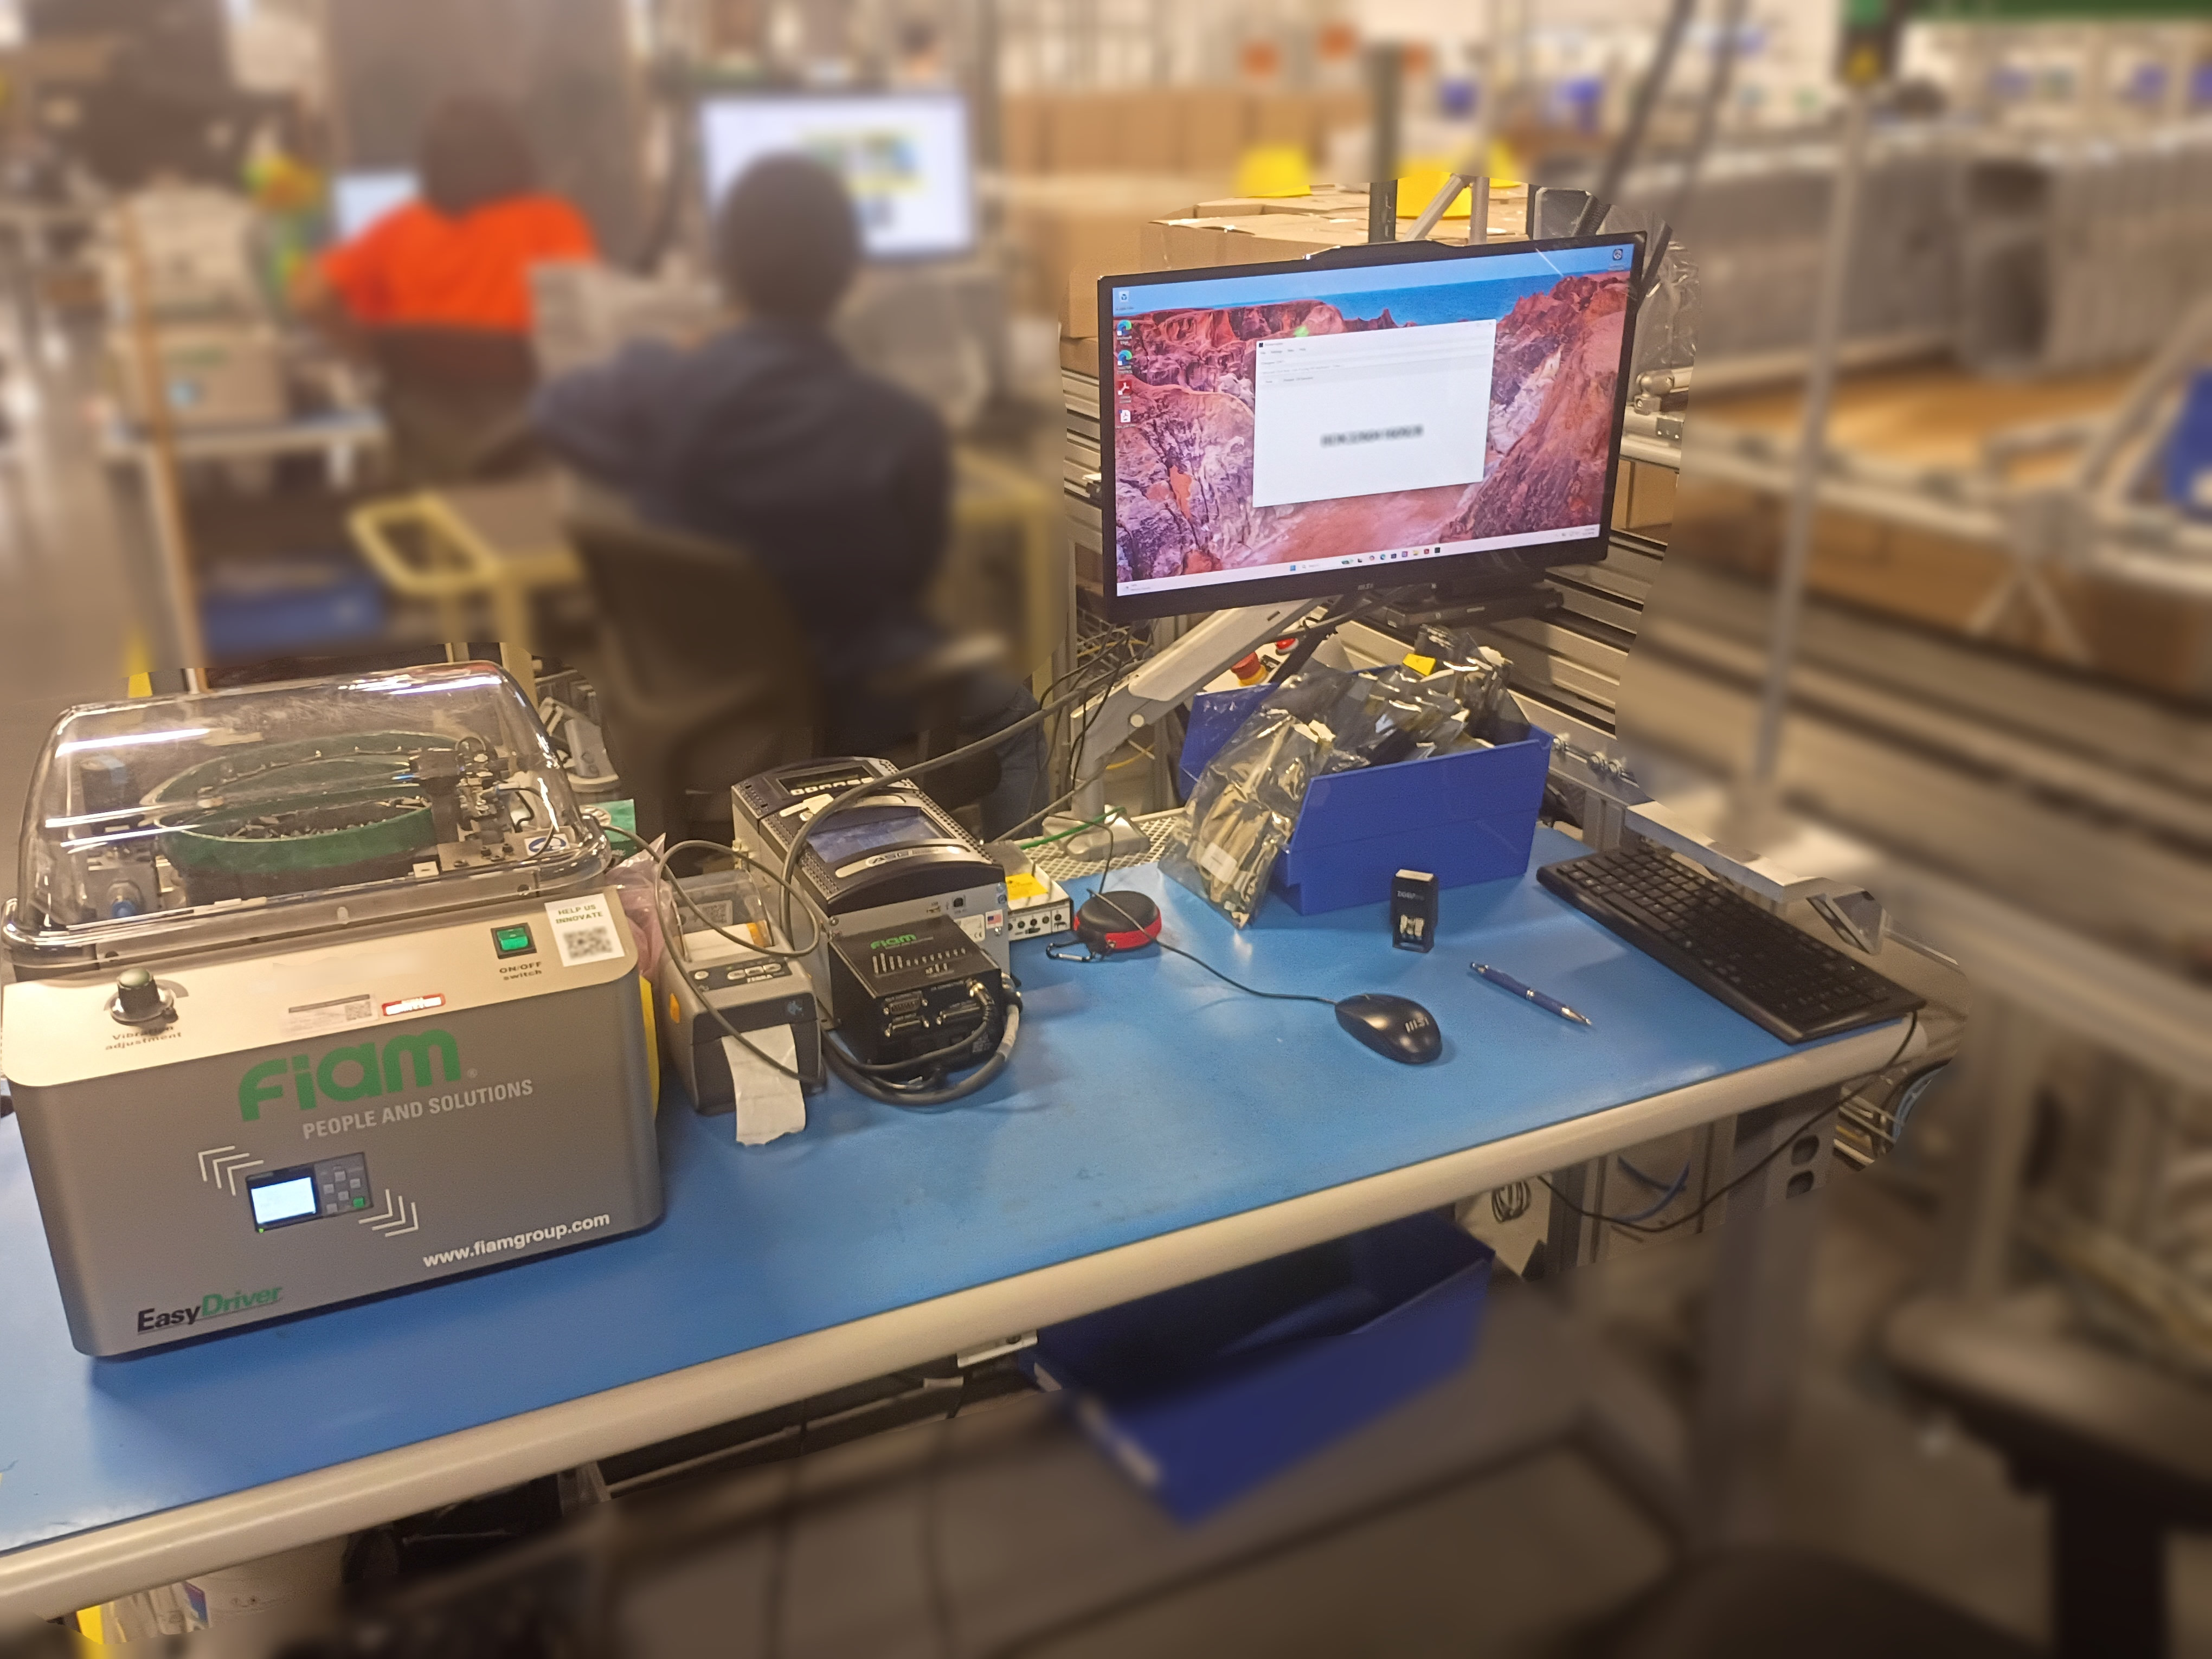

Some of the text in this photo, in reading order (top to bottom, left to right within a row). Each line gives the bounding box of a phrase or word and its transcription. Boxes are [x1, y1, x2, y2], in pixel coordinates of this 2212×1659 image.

[558, 906, 581, 915] HELP
[555, 911, 603, 924] INNOVATE
[499, 961, 542, 974] ON/OFF
[503, 970, 542, 981] switch
[105, 1032, 182, 1050] adjustment
[303, 1079, 533, 1139] PEOPLE AND SOLUTIONS
[423, 1214, 610, 1267] www.fiamgroup.com
